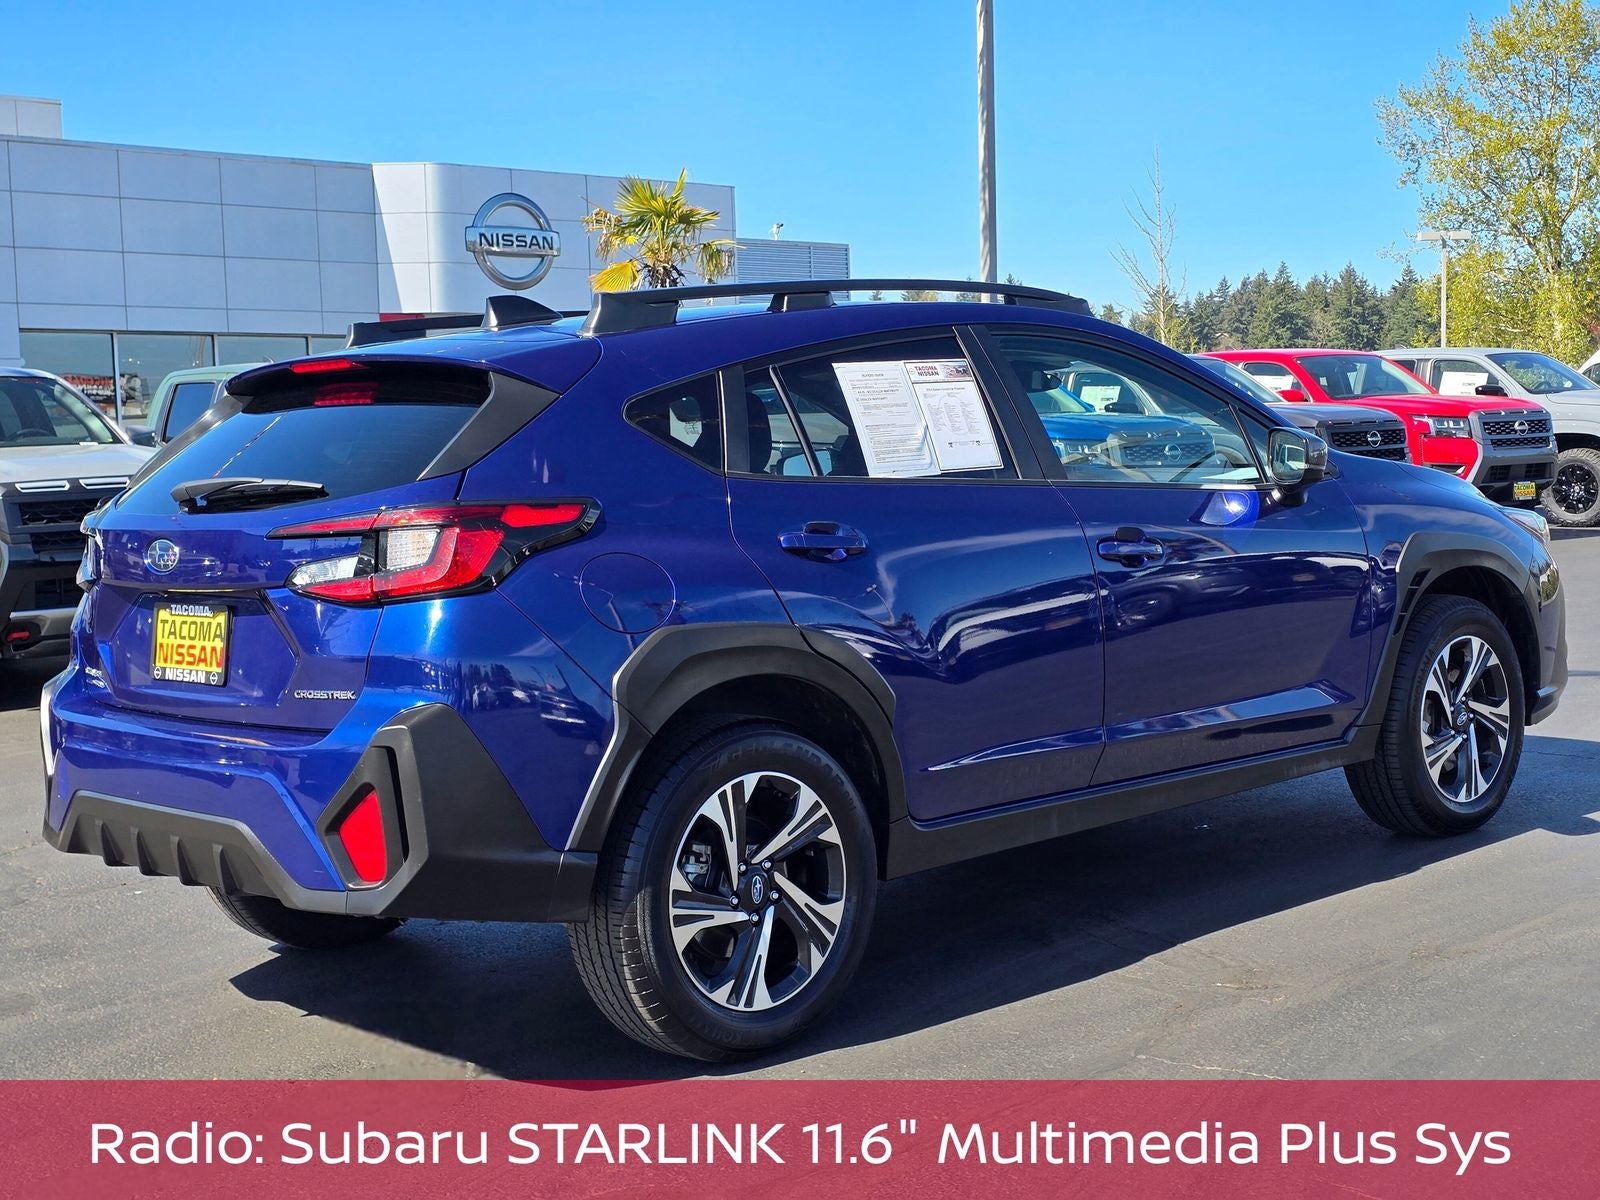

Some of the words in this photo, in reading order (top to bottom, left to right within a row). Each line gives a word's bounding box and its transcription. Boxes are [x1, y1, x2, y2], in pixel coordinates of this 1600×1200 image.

[479, 232, 554, 250] NISSAN
[170, 604, 211, 616] TACOMA
[159, 619, 224, 642] TACOMA
[157, 642, 225, 668] NISSAN
[165, 667, 206, 683] NISSAN
[294, 689, 357, 700] CROSSTREK
